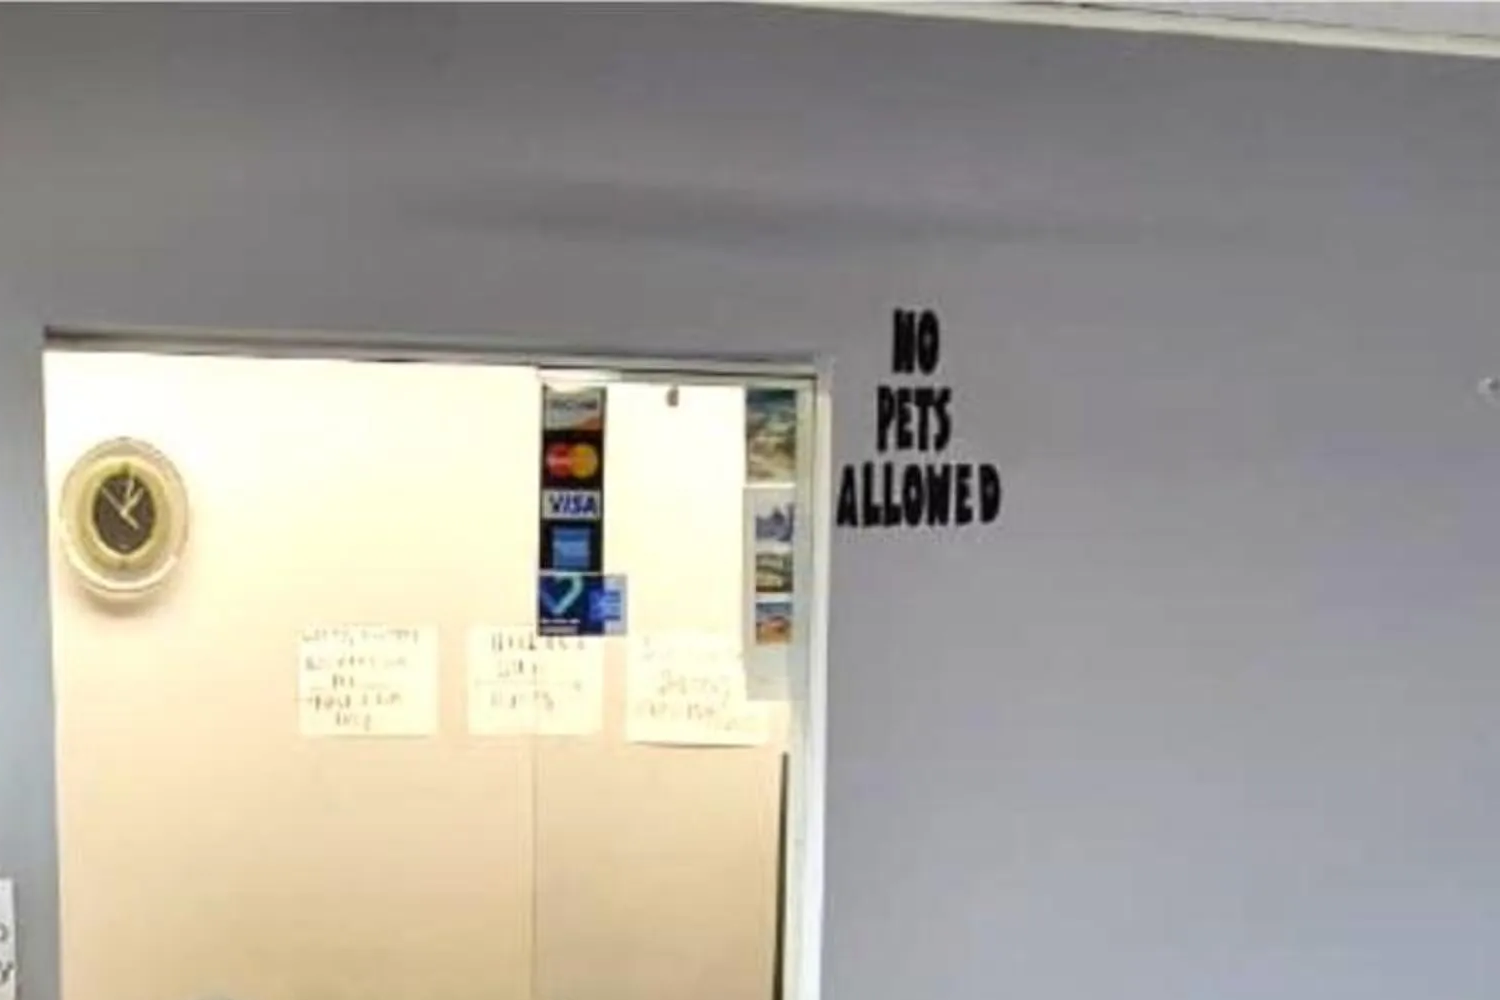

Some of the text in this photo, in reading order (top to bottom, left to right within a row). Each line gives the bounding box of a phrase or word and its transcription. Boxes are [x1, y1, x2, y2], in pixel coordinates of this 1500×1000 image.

[892, 309, 939, 375] NO
[877, 386, 951, 452] PETS
[548, 493, 597, 515] VISA
[836, 461, 1002, 527] ALLOWED
